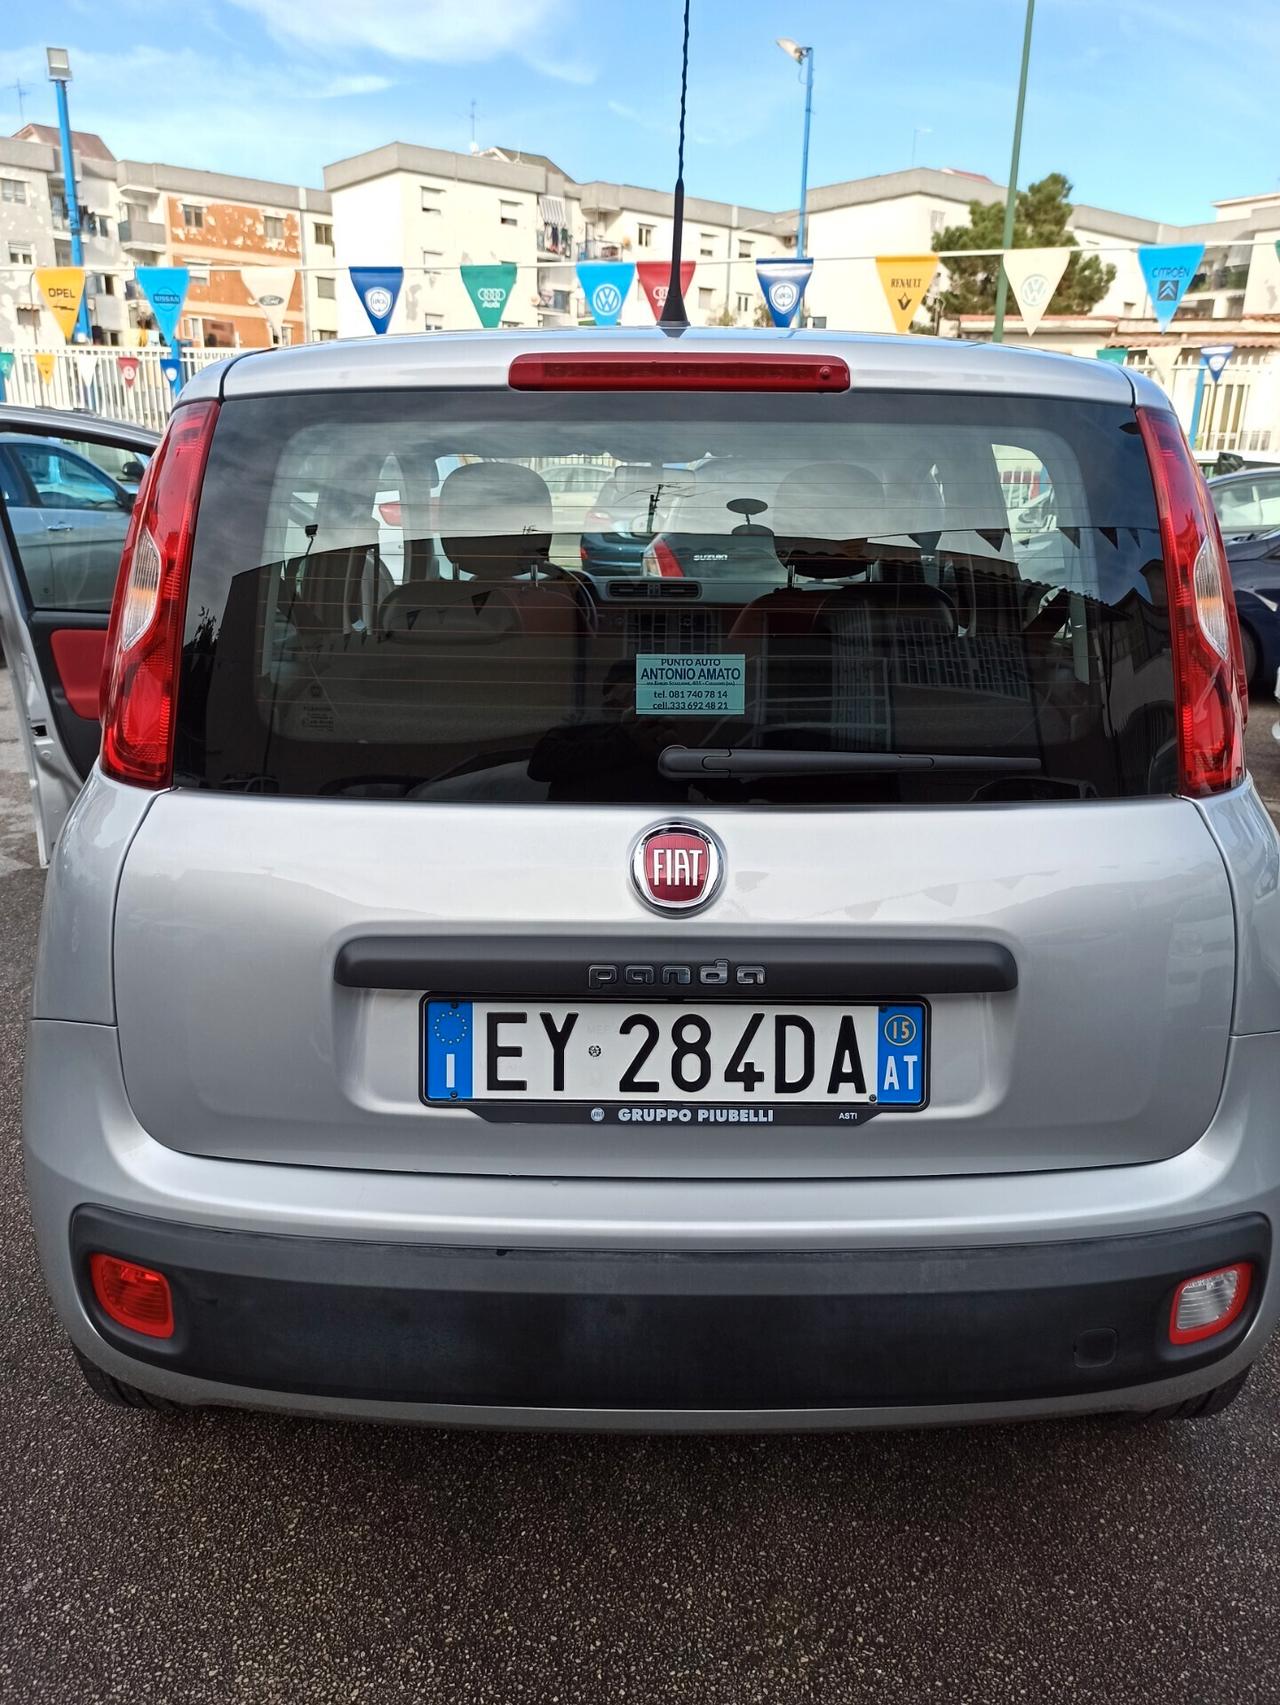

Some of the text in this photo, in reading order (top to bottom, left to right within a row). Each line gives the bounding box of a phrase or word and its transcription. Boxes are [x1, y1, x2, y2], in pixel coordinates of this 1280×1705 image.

[890, 278, 922, 288] RENAULT
[48, 287, 76, 298] OPEL
[661, 658, 721, 667] PUNTO AUTO
[640, 667, 741, 680] ANTONIO AMATO
[653, 690, 728, 699] tel. 081 740 78 14
[687, 701, 703, 710] 692
[704, 701, 716, 710] 48
[717, 701, 729, 710] 21
[652, 848, 703, 887] FIAT
[588, 958, 766, 989] panda
[893, 1020, 911, 1040] 15
[487, 1011, 867, 1094] EY 284DA
[883, 1055, 918, 1090] AT
[617, 1108, 692, 1122] GRUPPO
[697, 1108, 774, 1122] PIUBELLI
[838, 1112, 858, 1120] ASTI
